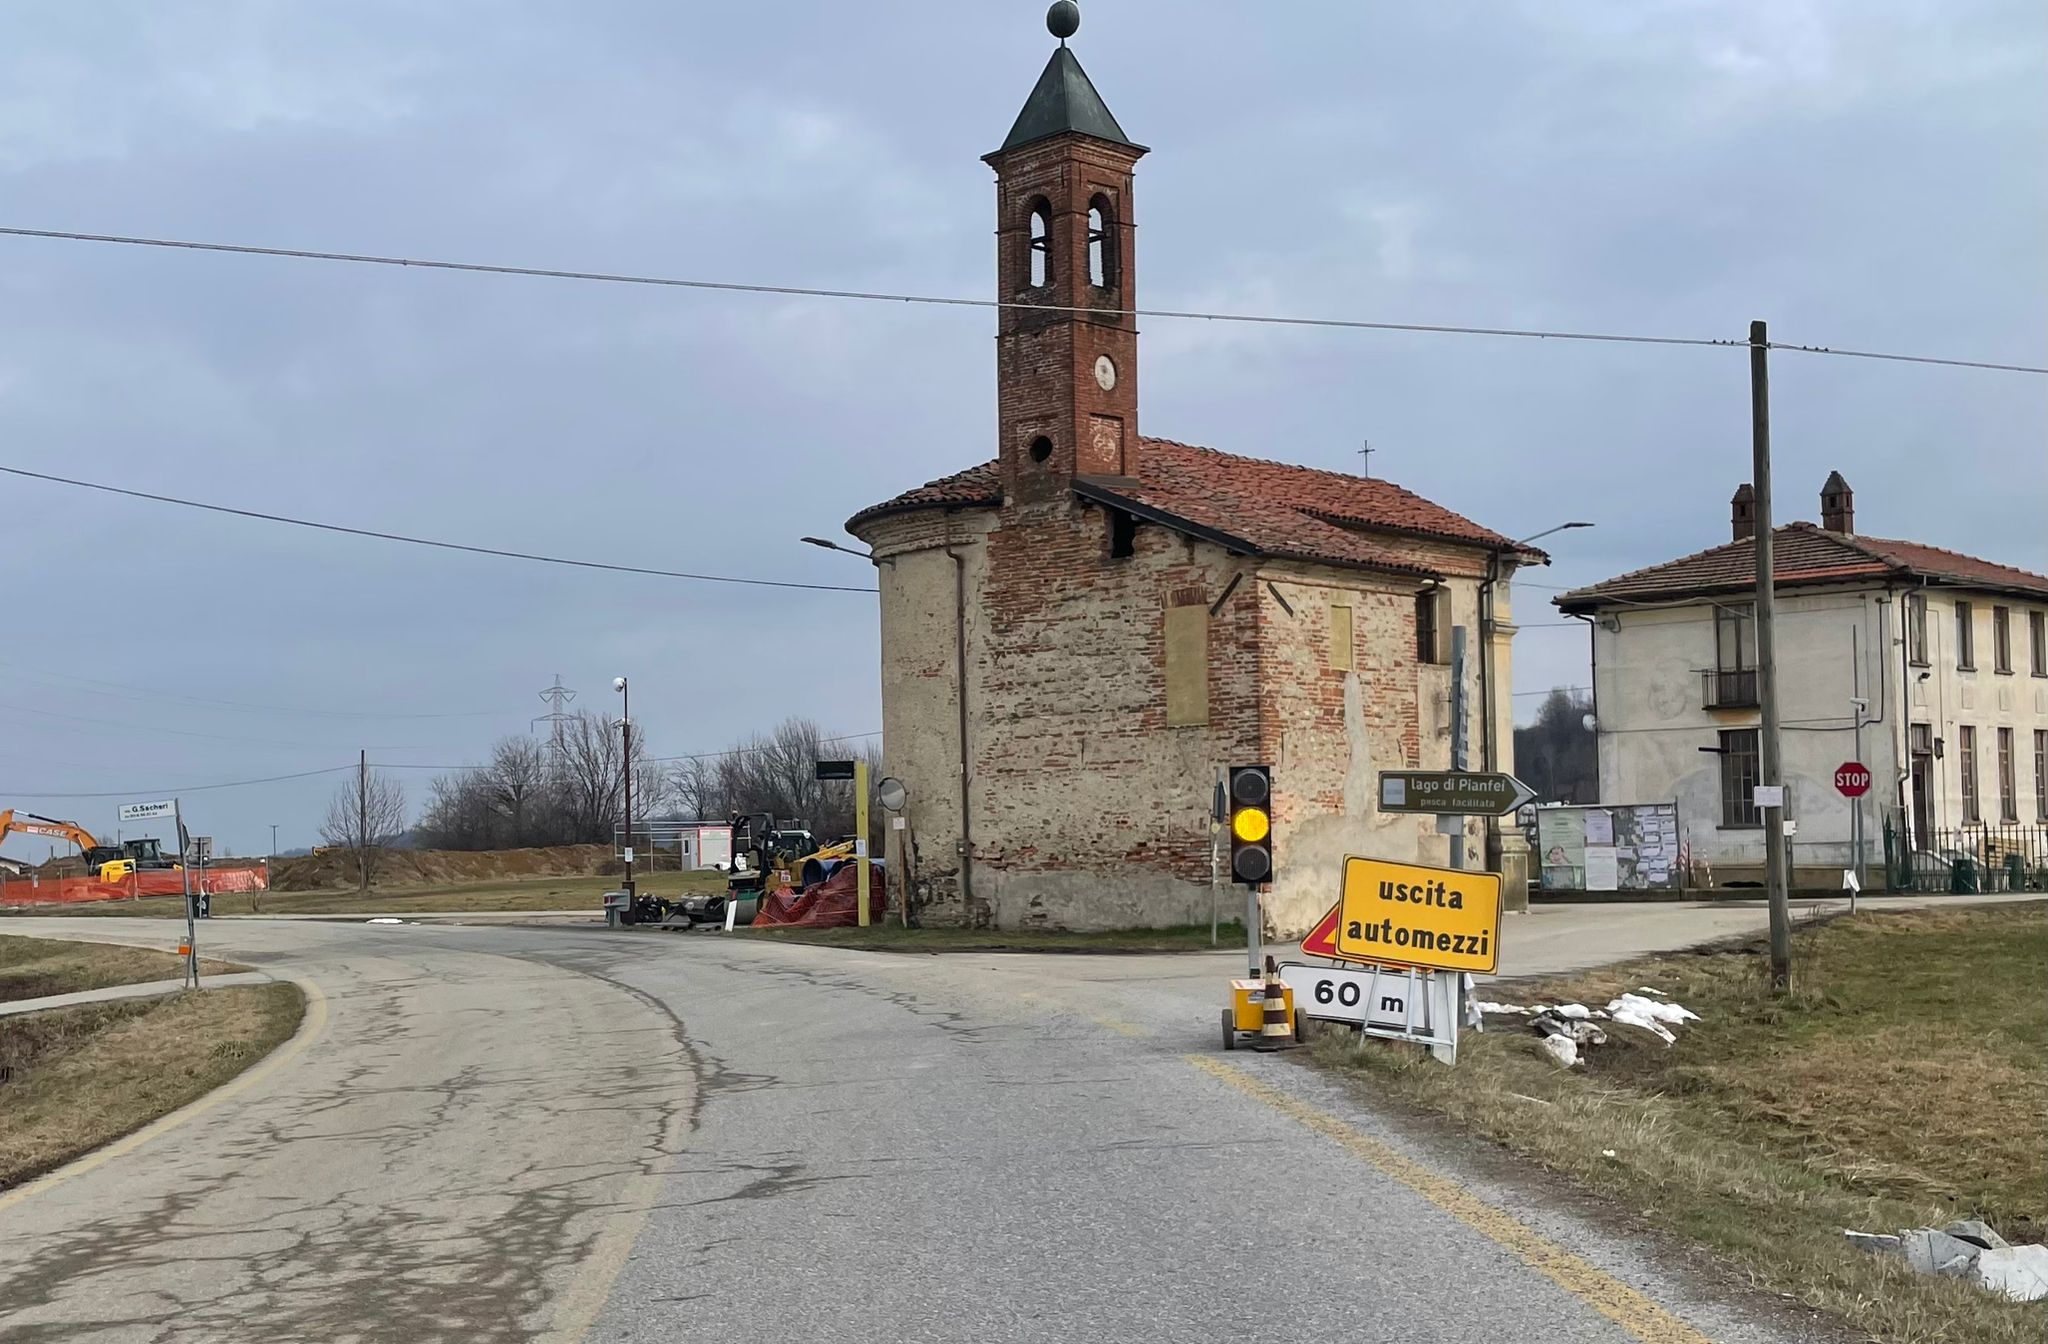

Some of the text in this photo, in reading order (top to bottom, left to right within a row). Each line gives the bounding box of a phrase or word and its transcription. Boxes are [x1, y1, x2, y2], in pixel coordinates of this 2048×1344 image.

[1443, 777, 1455, 791] di
[1458, 778, 1505, 792] Pianfei
[1836, 772, 1869, 787] STOP
[1452, 797, 1496, 808] facilitata
[38, 827, 68, 838] CASE
[1379, 880, 1463, 909] uscita
[1347, 918, 1489, 955] automezzi
[1314, 979, 1404, 1013] 60 m
